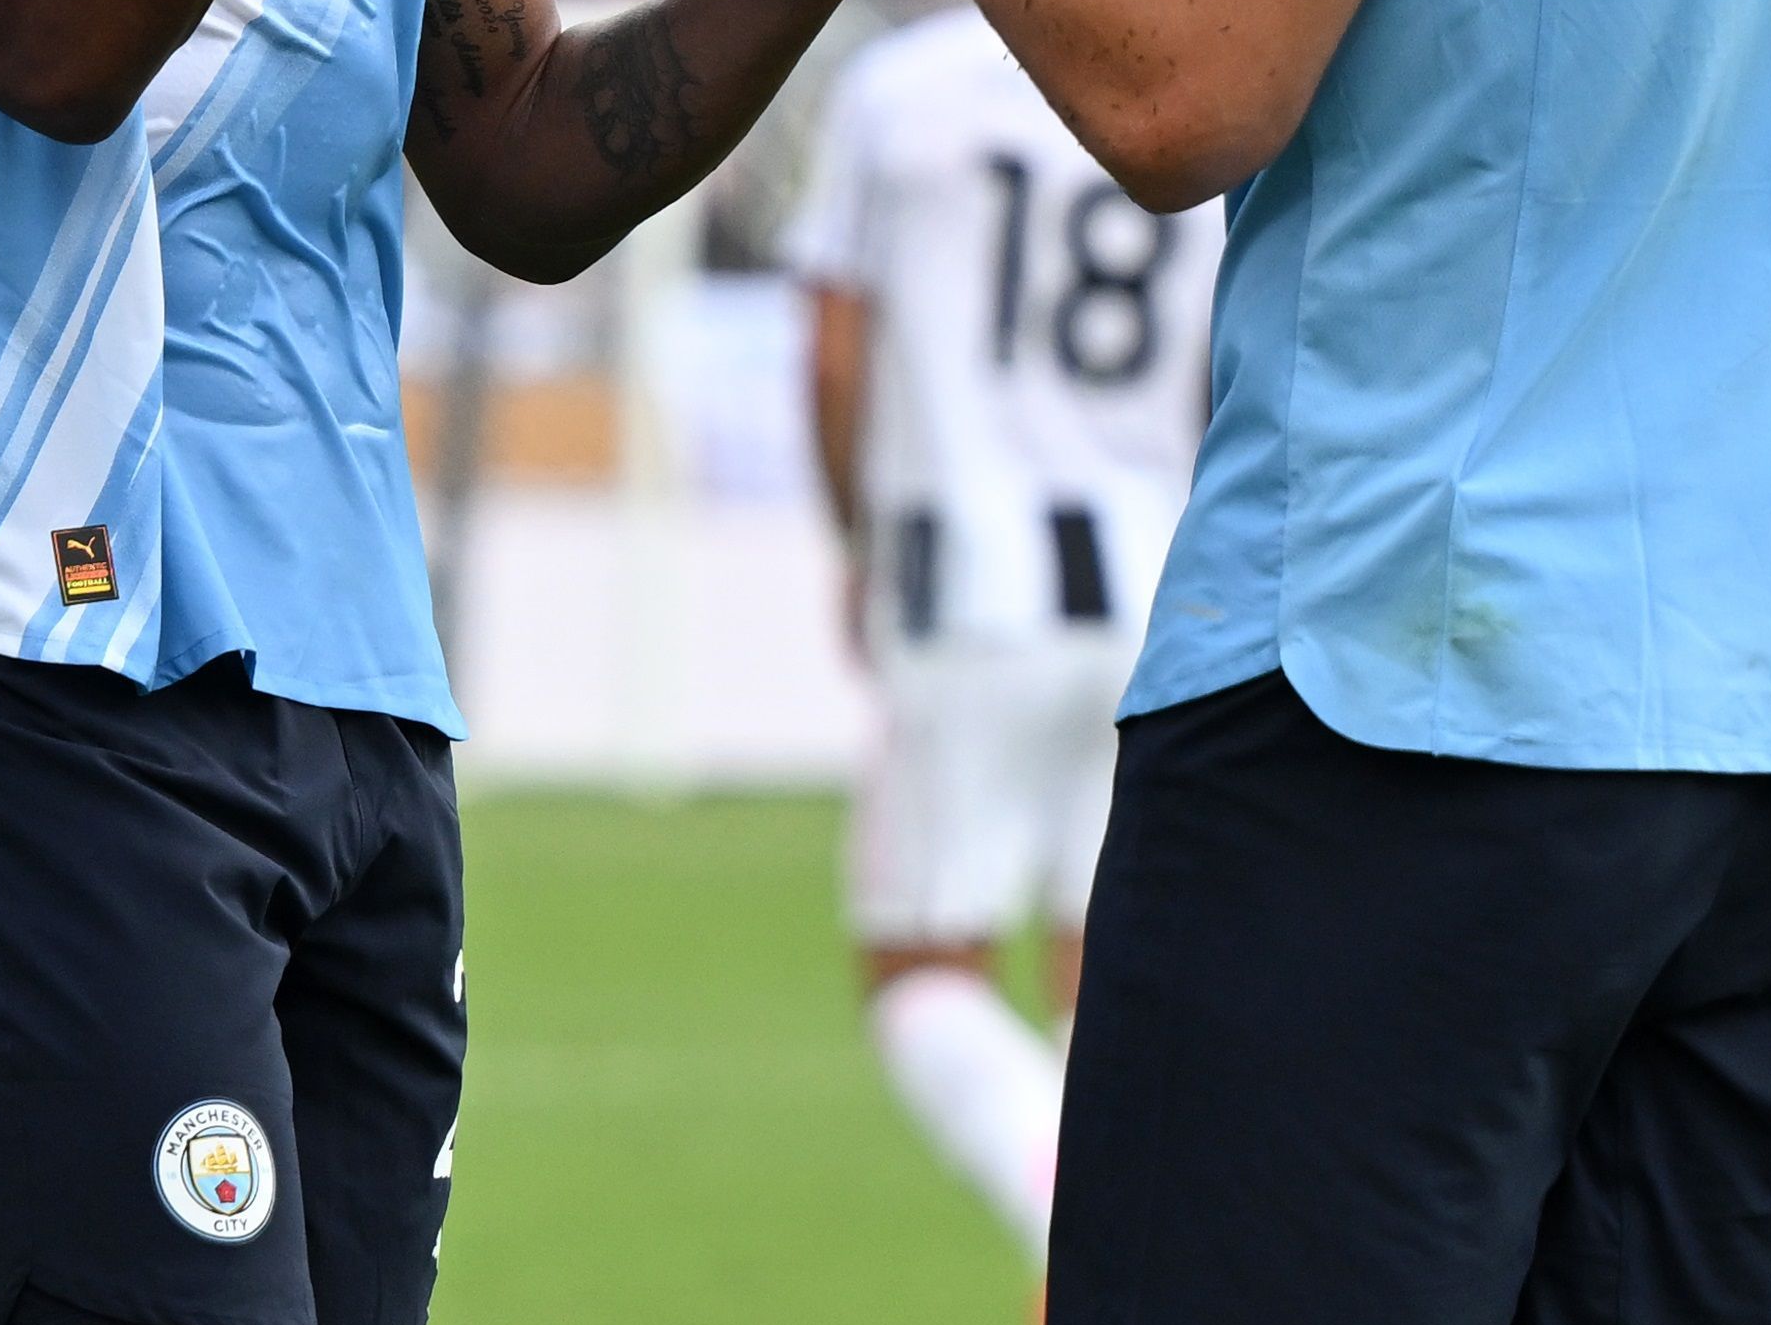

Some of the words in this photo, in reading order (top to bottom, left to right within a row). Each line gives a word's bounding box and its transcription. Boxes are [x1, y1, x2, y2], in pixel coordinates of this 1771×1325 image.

[981, 152, 1184, 380] 18
[166, 1109, 263, 1156] MANCHESTER
[214, 1219, 247, 1232] CITY
